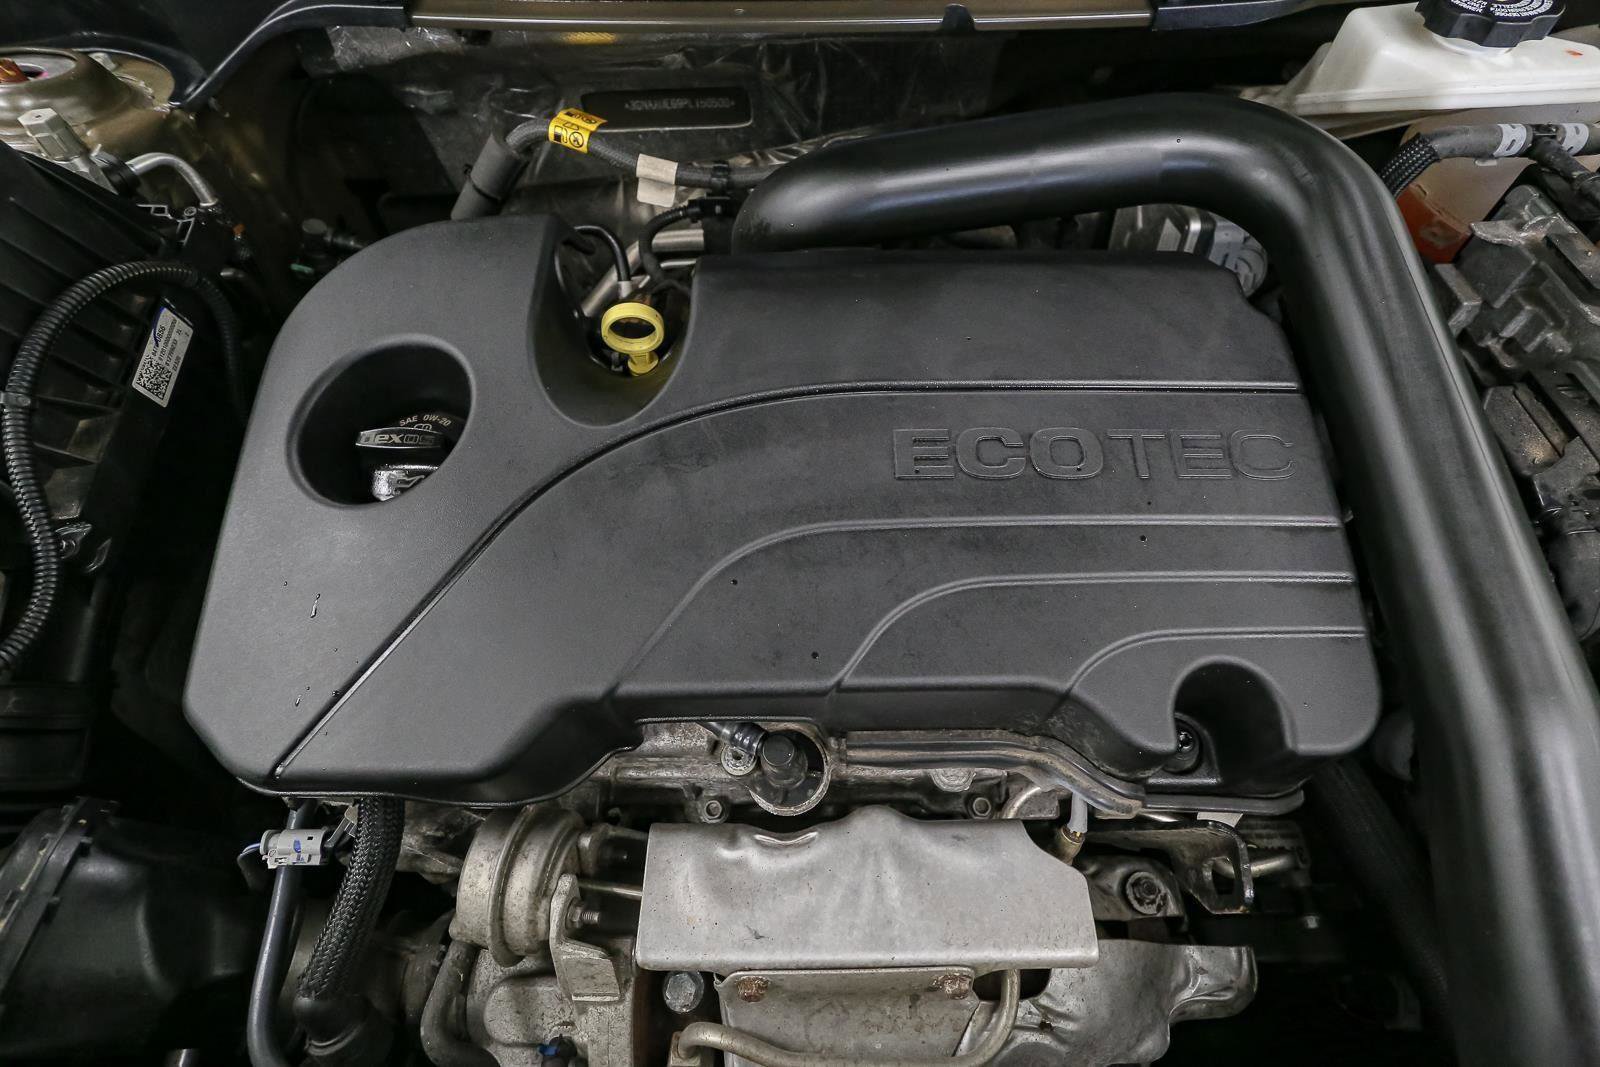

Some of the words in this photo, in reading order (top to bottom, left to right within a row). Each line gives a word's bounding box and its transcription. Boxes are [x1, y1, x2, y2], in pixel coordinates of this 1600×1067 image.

[400, 415, 418, 427] SAE
[423, 414, 452, 427] 0W-20
[893, 427, 1297, 480] ECOTEC
